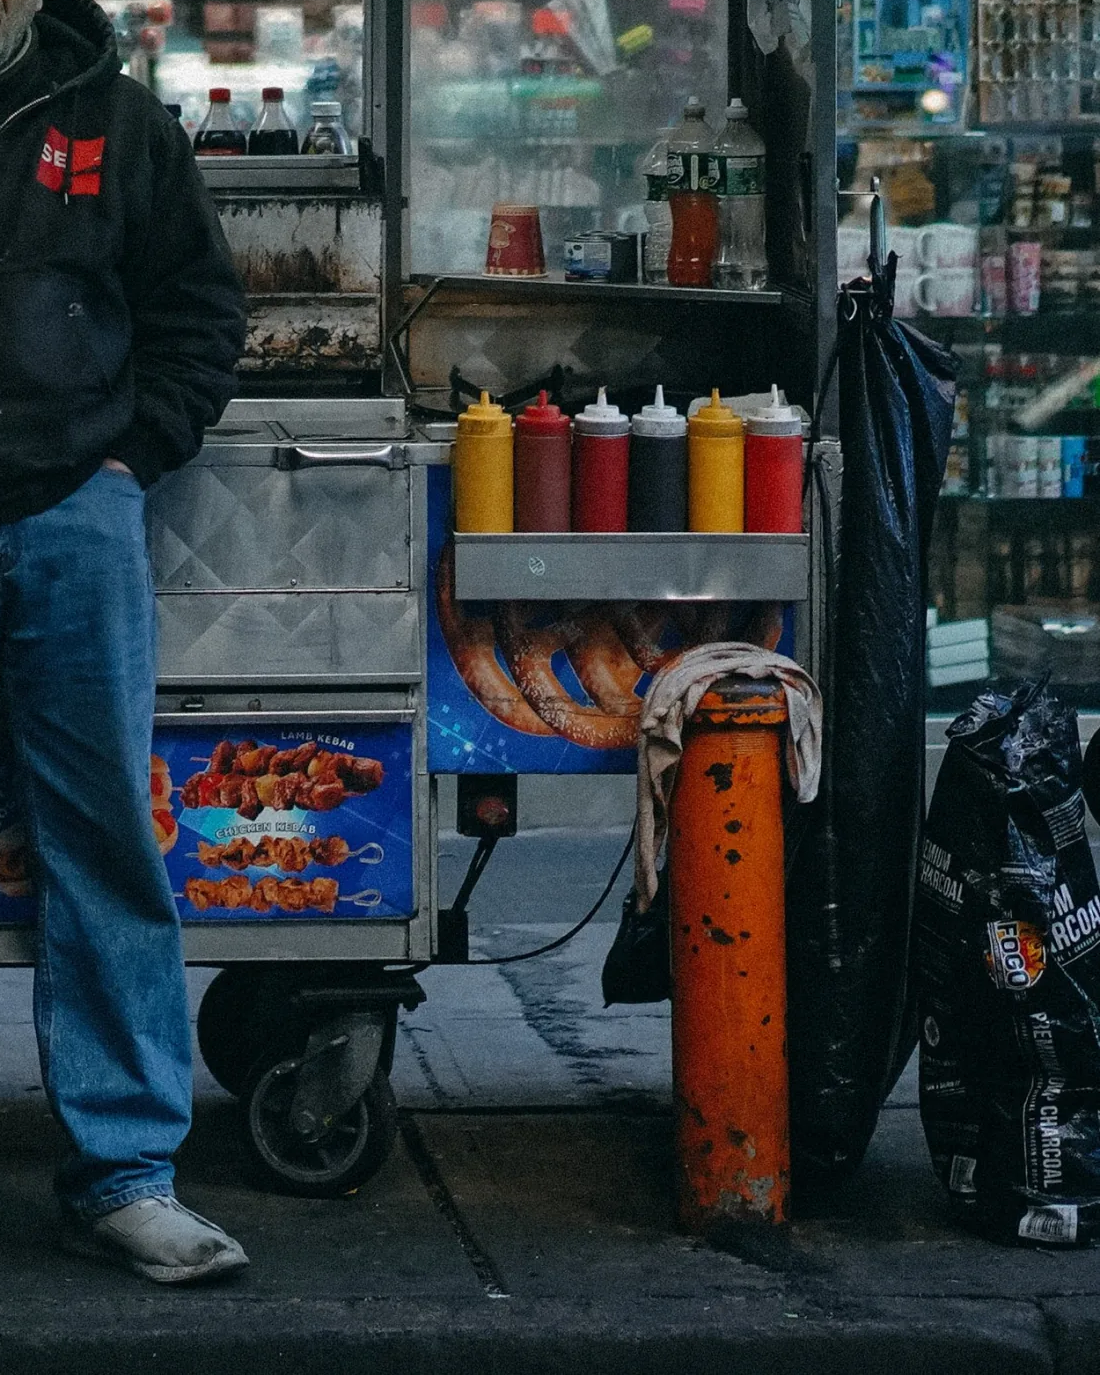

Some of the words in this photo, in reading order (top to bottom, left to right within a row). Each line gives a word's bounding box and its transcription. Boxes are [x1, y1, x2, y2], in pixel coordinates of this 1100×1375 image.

[40, 142, 68, 169] SE
[280, 730, 313, 742] LAMB
[316, 733, 357, 752] KEBAB
[214, 823, 272, 840] CHICKEN
[274, 821, 317, 836] KEBAB
[919, 862, 965, 905] HARCOAL
[996, 922, 1031, 989] FOGO
[1039, 1104, 1064, 1190] CHARCOAL
